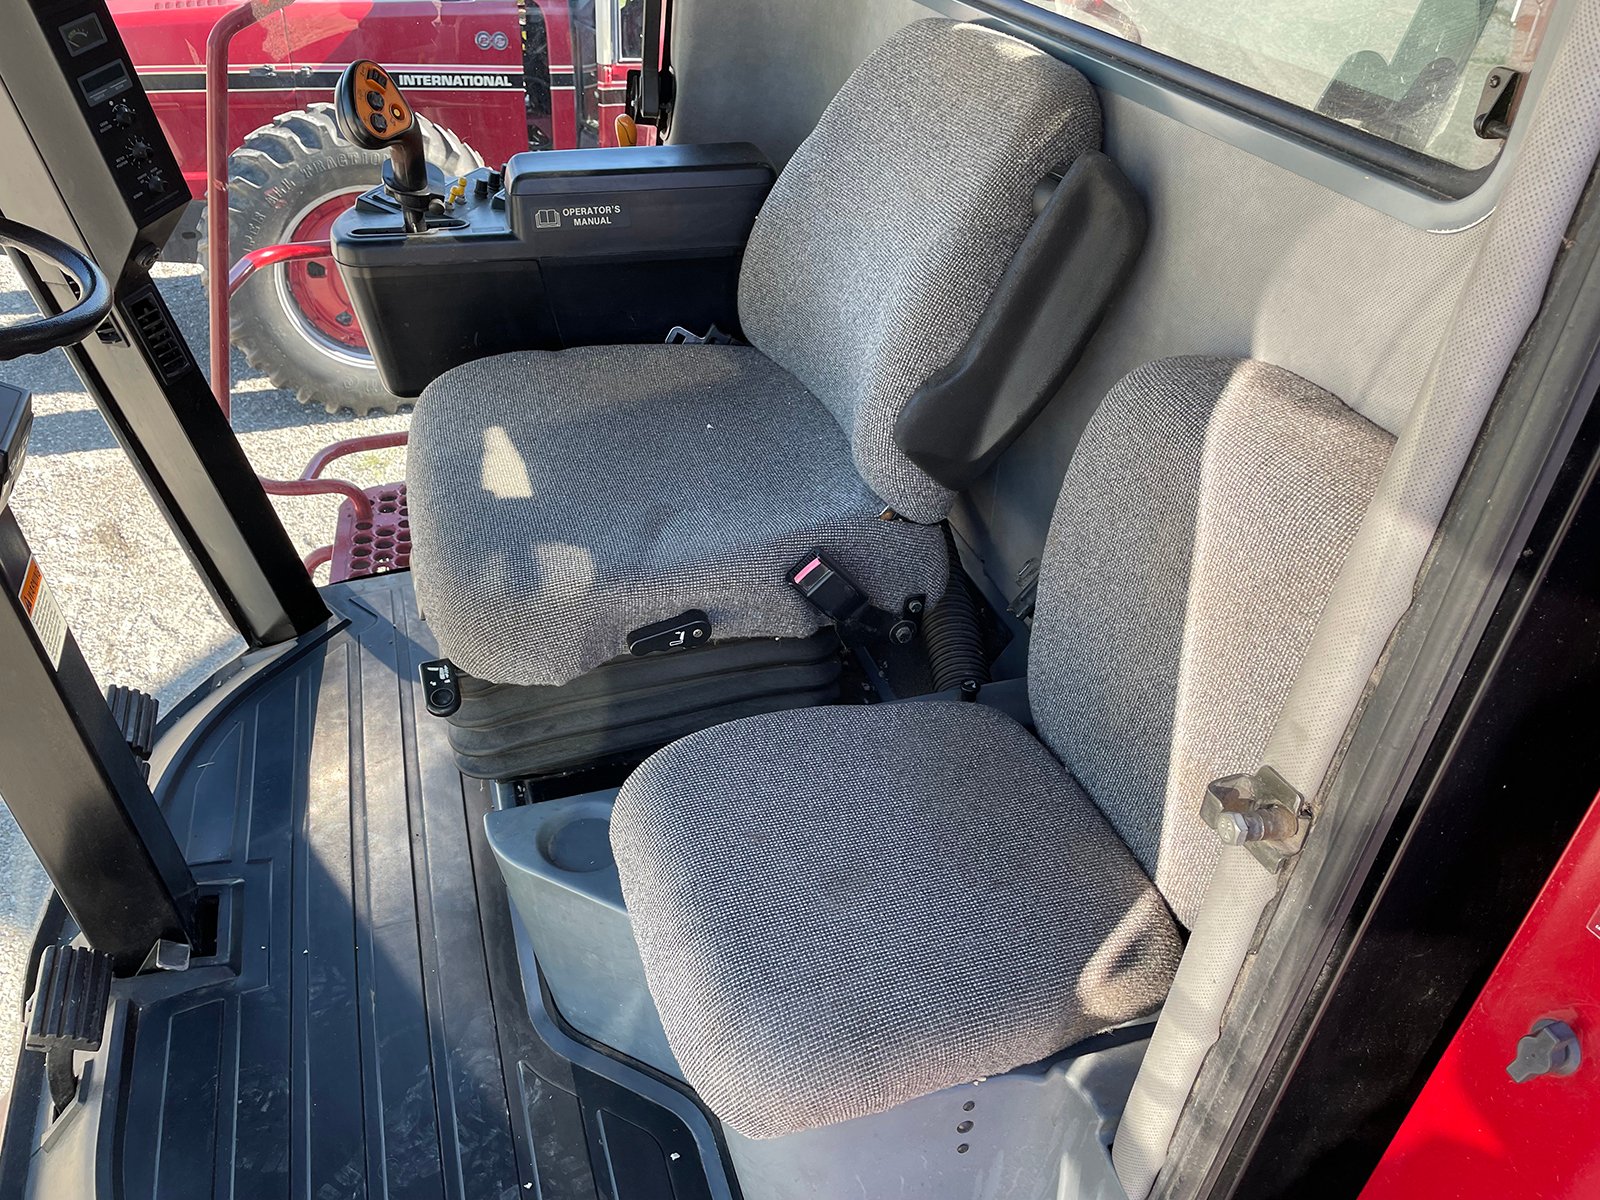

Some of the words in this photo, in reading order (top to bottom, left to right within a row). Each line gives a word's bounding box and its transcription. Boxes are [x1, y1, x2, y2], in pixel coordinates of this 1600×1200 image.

[398, 74, 513, 87] INTERNATIONAL
[562, 205, 621, 217] OPERATOR'S
[573, 216, 612, 226] MANUAL
